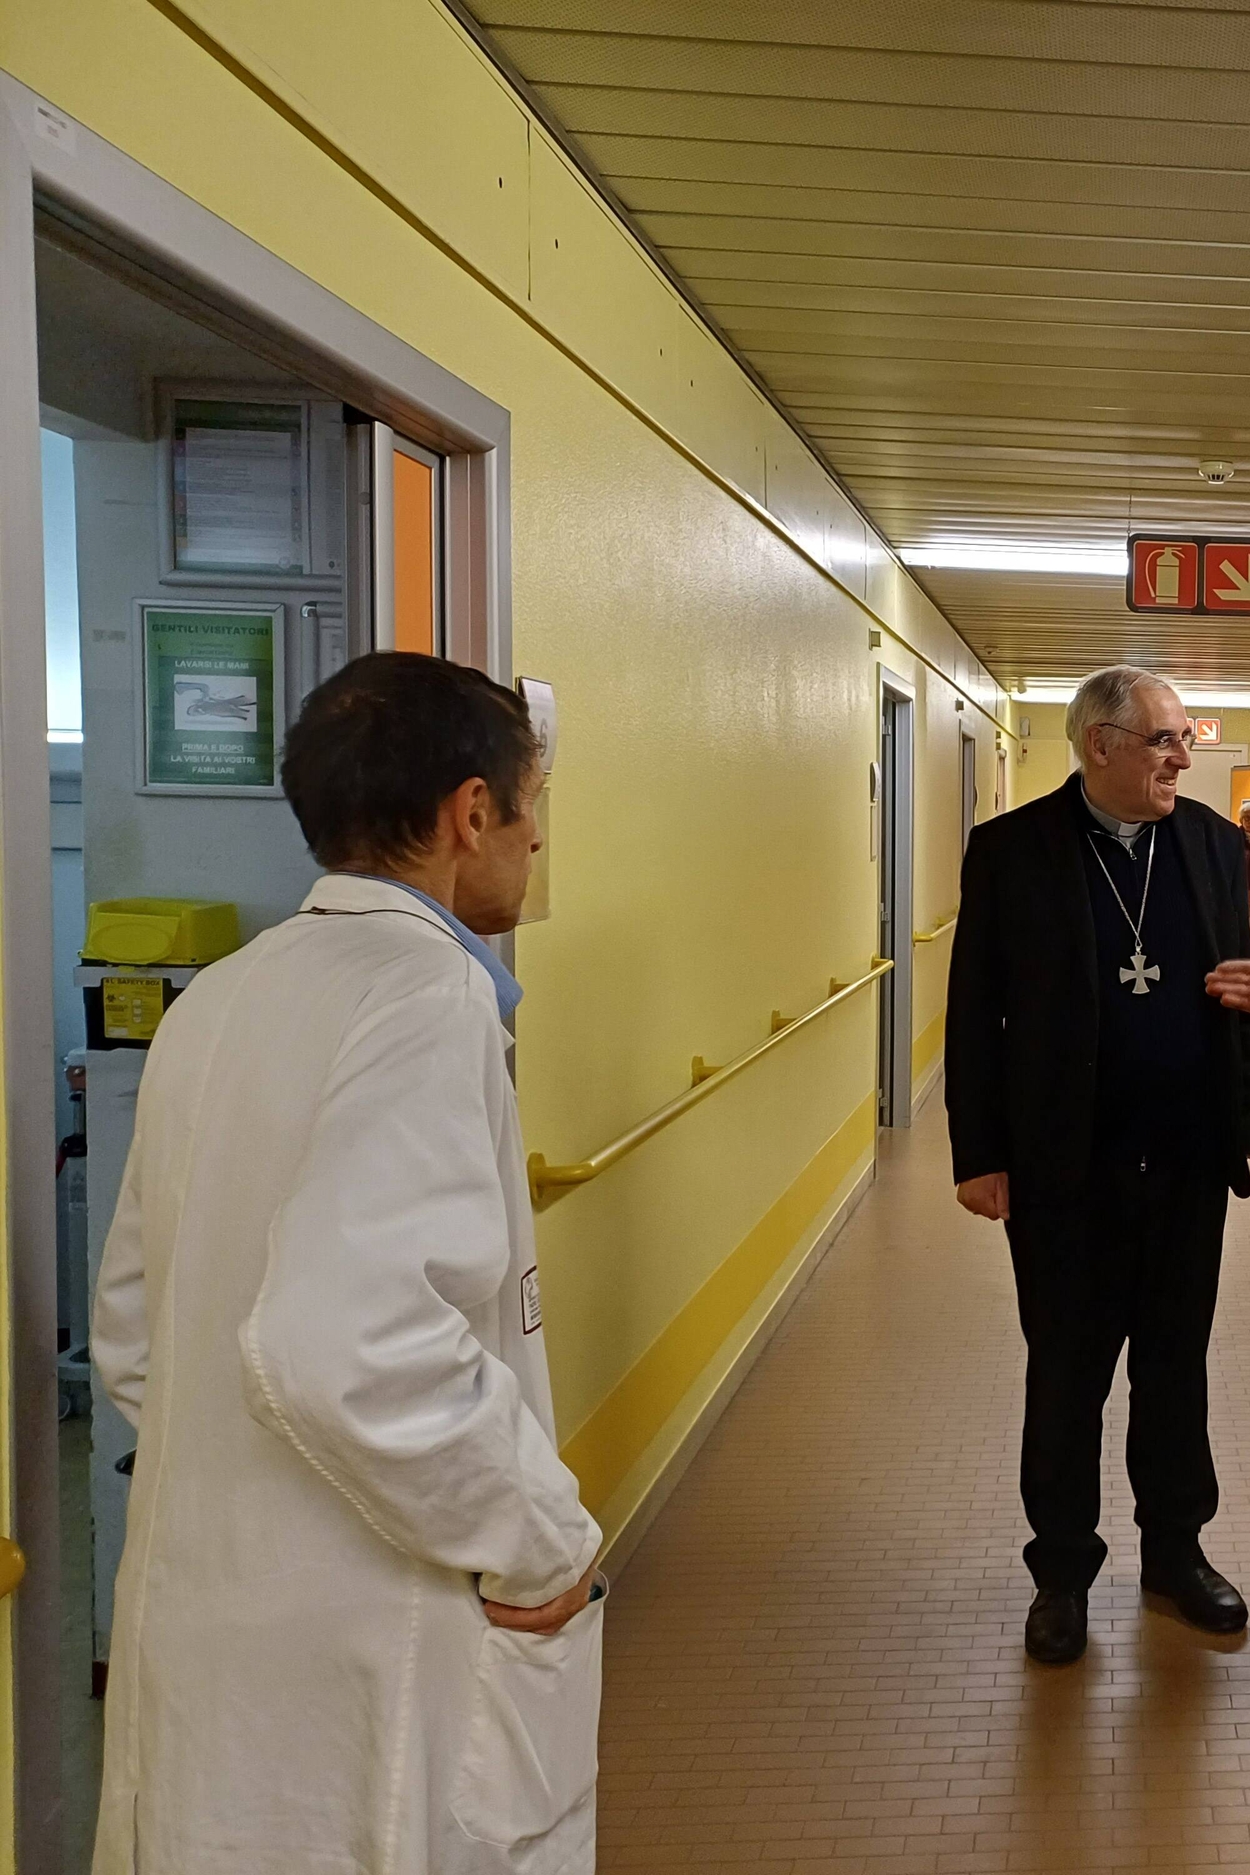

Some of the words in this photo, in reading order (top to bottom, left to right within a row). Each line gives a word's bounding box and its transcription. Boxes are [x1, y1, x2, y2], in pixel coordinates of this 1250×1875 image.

[152, 624, 198, 633] GENTILI
[202, 625, 269, 636] VISITATORI
[175, 660, 212, 668] LAVARSI
[214, 661, 225, 669] LE
[227, 661, 249, 669] MANI
[182, 743, 208, 751] PRIMA
[219, 744, 244, 752] DOPO
[184, 755, 211, 763] VISITA
[225, 756, 256, 764] VOSTRI
[192, 766, 235, 774] FAMILIARI
